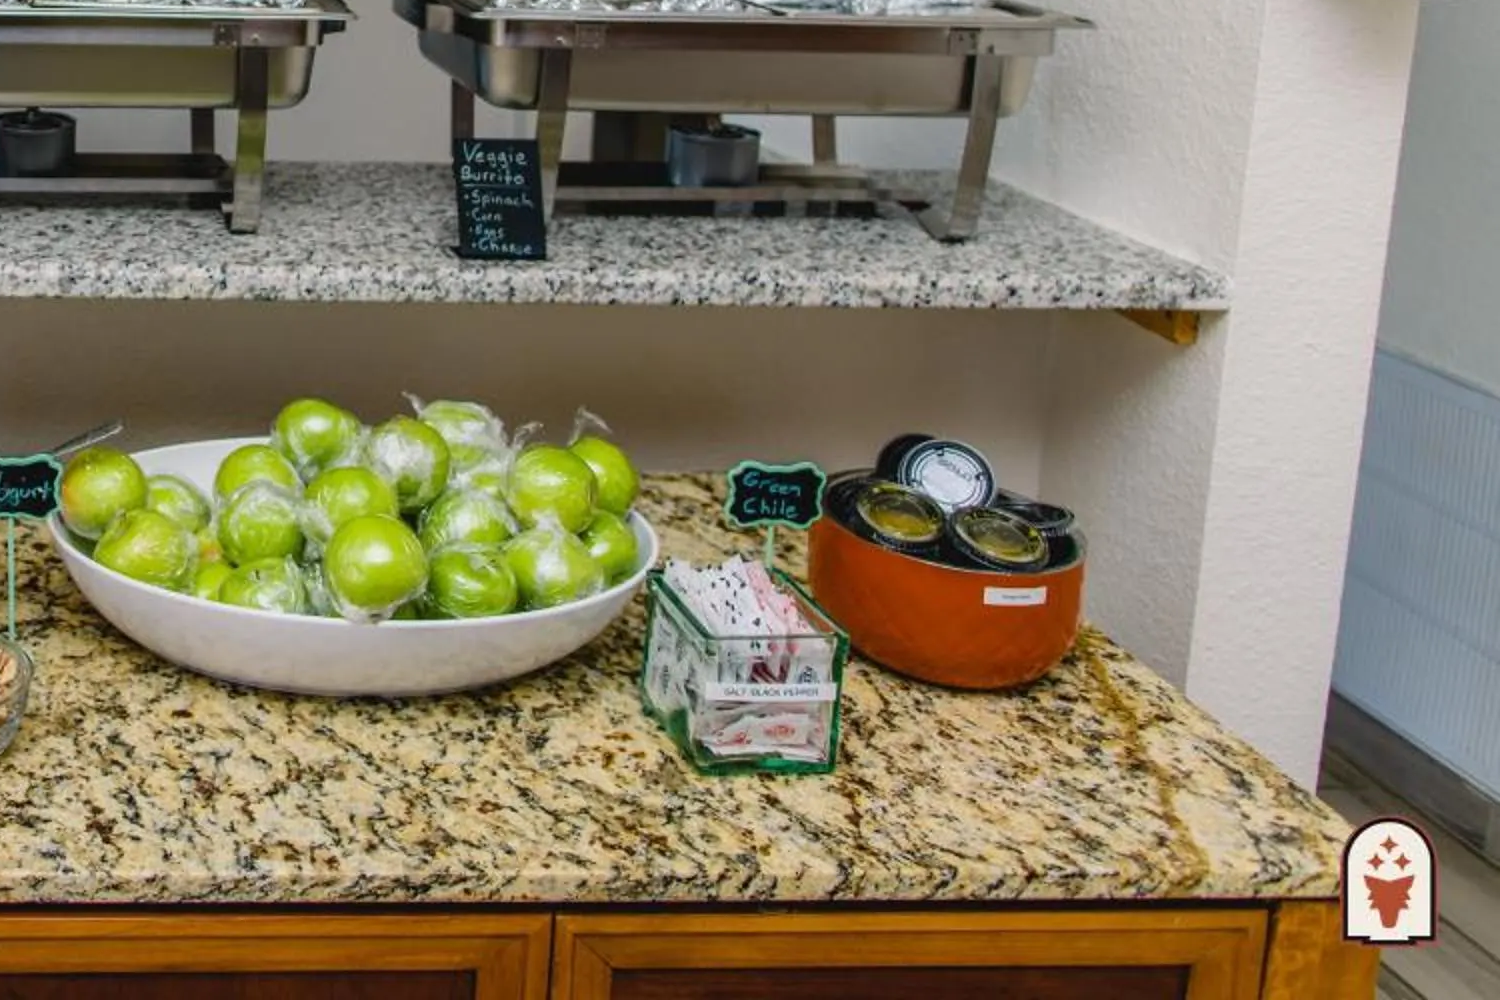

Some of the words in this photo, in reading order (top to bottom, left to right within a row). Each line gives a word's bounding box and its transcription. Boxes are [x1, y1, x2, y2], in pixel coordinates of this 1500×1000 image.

[462, 141, 527, 169] Veggie
[461, 165, 525, 185] Burrito
[471, 189, 534, 209] Spinach
[742, 470, 802, 497] Green
[743, 497, 799, 519] Chile
